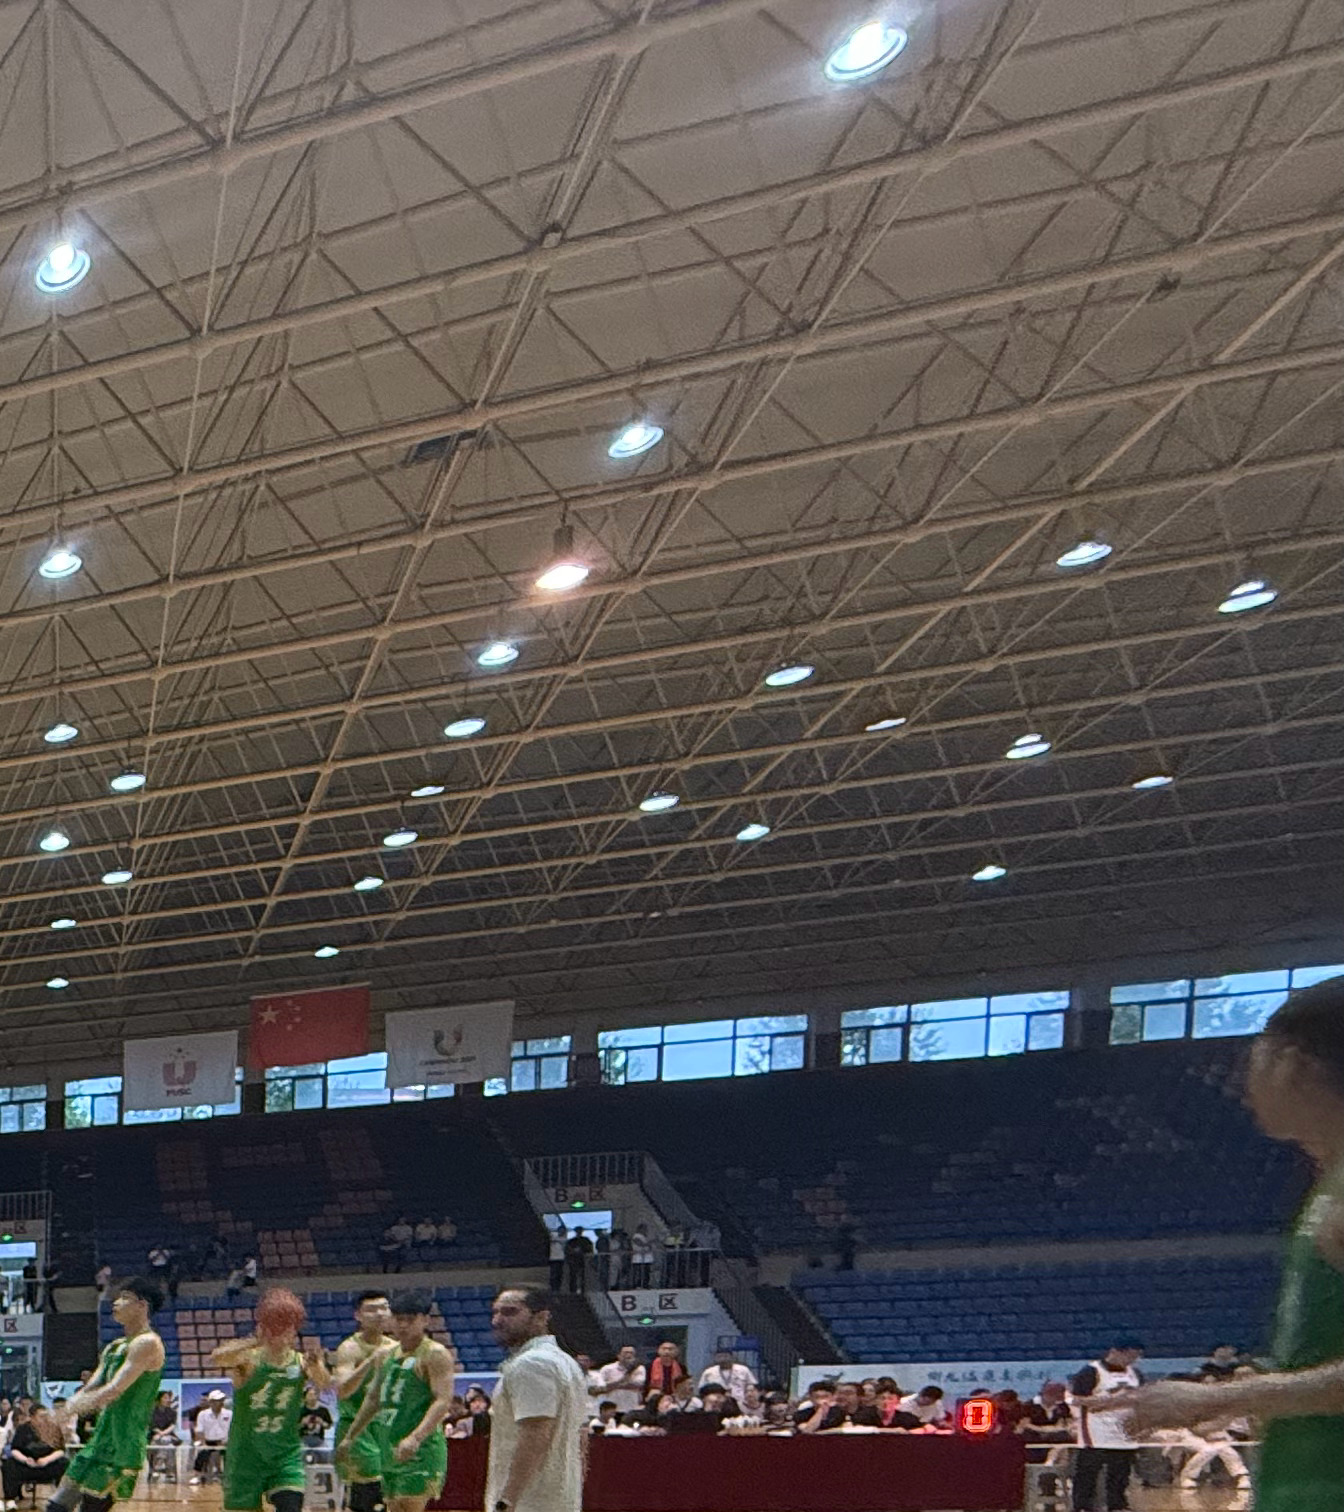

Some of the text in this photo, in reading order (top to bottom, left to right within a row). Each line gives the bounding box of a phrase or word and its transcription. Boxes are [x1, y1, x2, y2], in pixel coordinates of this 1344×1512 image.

[555, 1189, 568, 1202] B
[622, 1293, 679, 1311] B 区
[4, 1318, 18, 1333] 区
